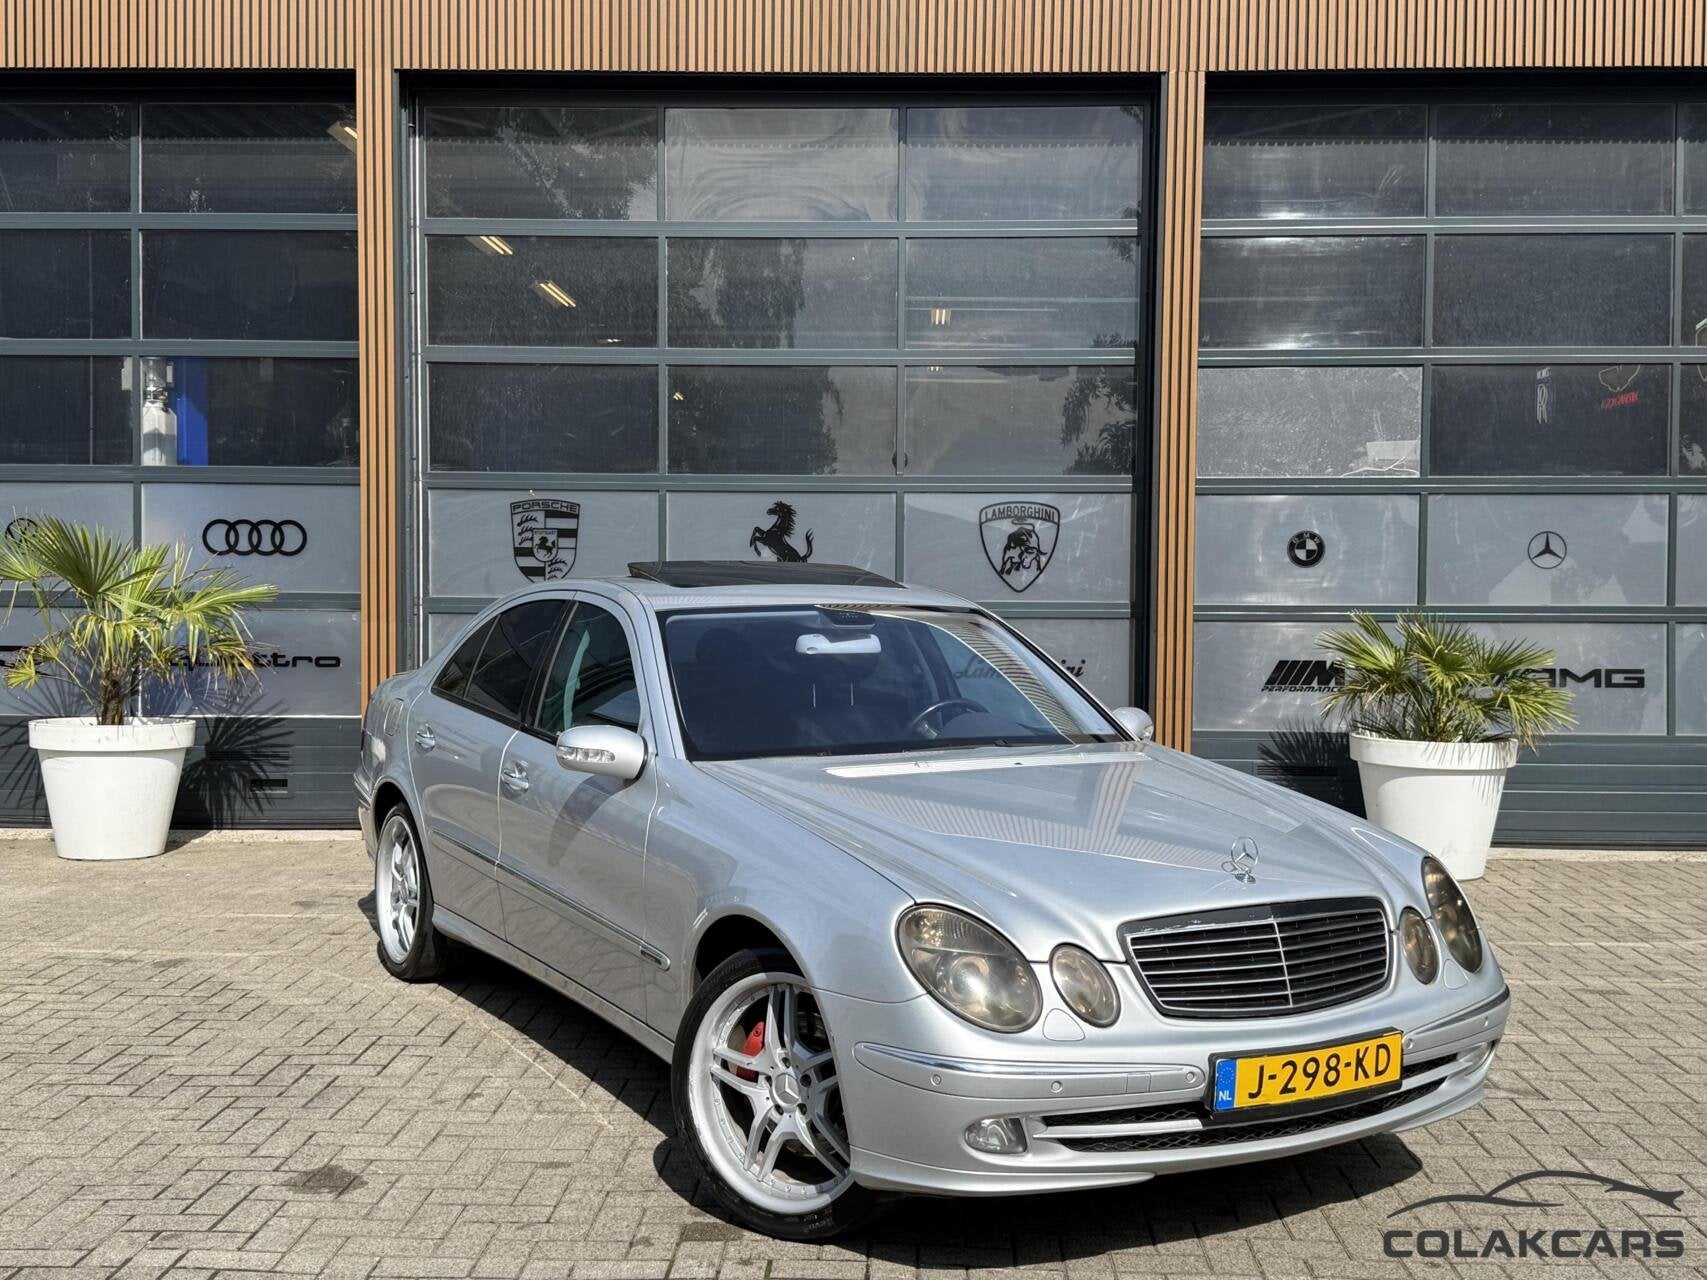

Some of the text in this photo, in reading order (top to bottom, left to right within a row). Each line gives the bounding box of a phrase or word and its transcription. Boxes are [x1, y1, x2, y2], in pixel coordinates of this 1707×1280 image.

[512, 501, 578, 512] PORSCHE
[984, 505, 1055, 520] LAMBORGHINI
[1248, 1043, 1391, 1099] J-298-KD
[1218, 1090, 1233, 1101] NL
